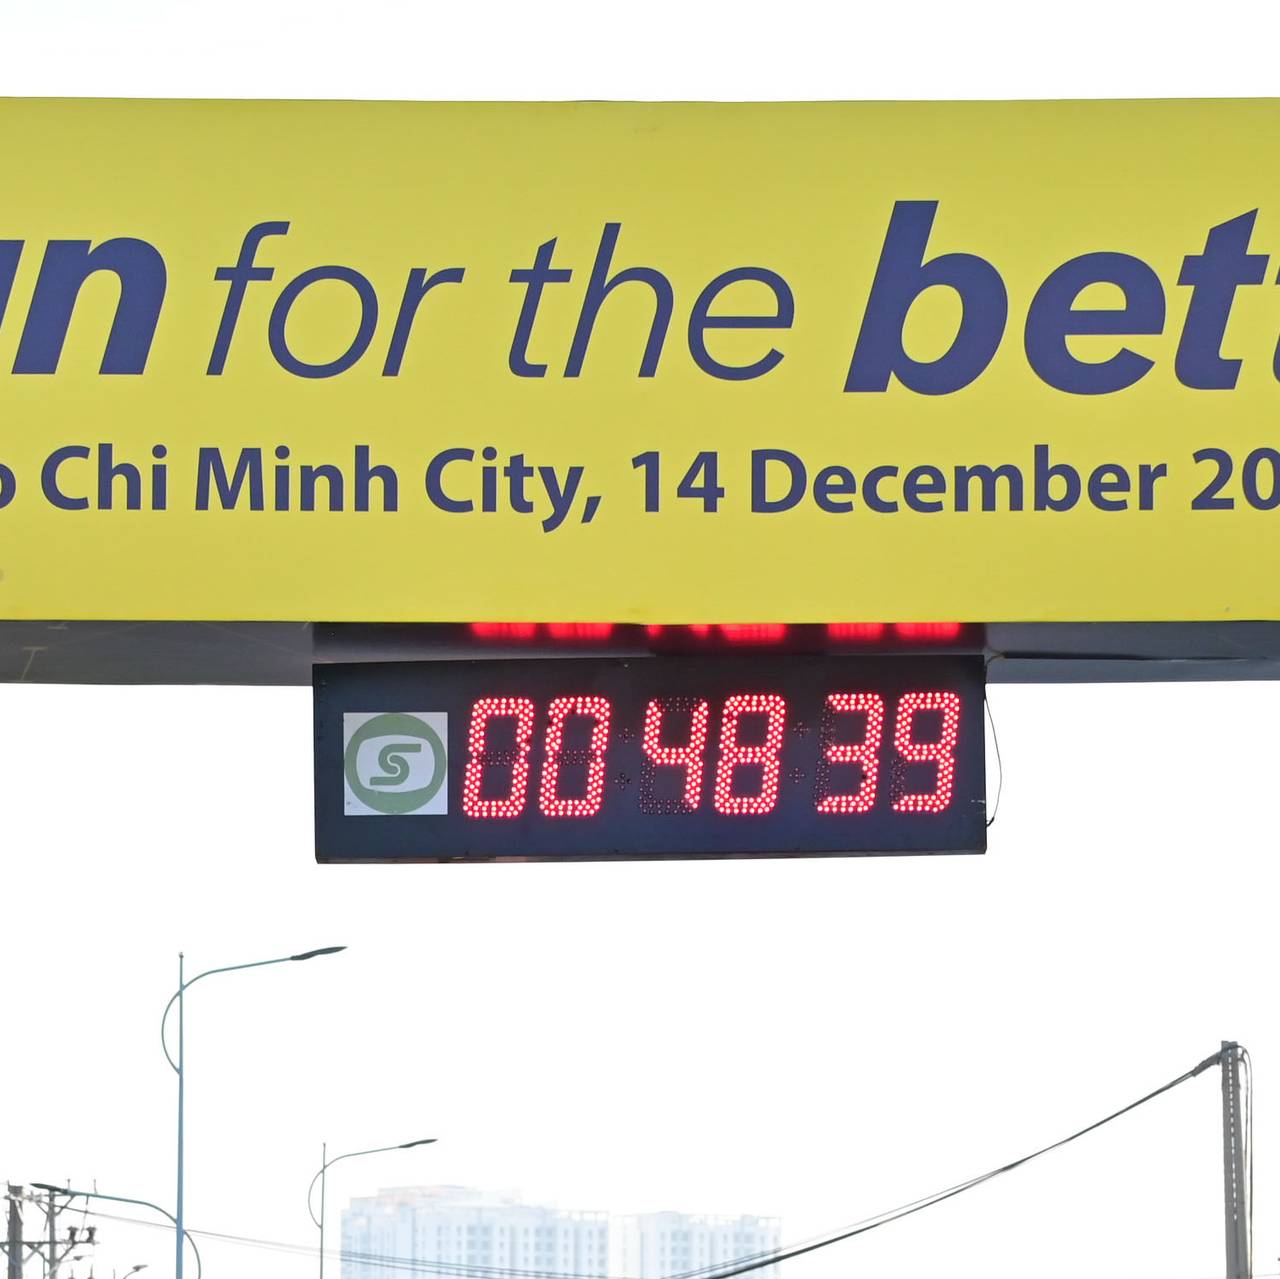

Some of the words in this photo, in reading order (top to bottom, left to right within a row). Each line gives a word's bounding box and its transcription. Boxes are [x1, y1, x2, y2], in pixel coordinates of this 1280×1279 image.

[207, 221, 465, 379] for
[509, 223, 795, 380] the
[40, 443, 168, 511] Chi
[195, 444, 399, 512] Minh
[425, 448, 601, 532] City,
[632, 451, 725, 513] 14
[751, 444, 1168, 513] December
[463, 696, 613, 817] 00
[643, 694, 786, 814] 48
[817, 692, 960, 813] 39
